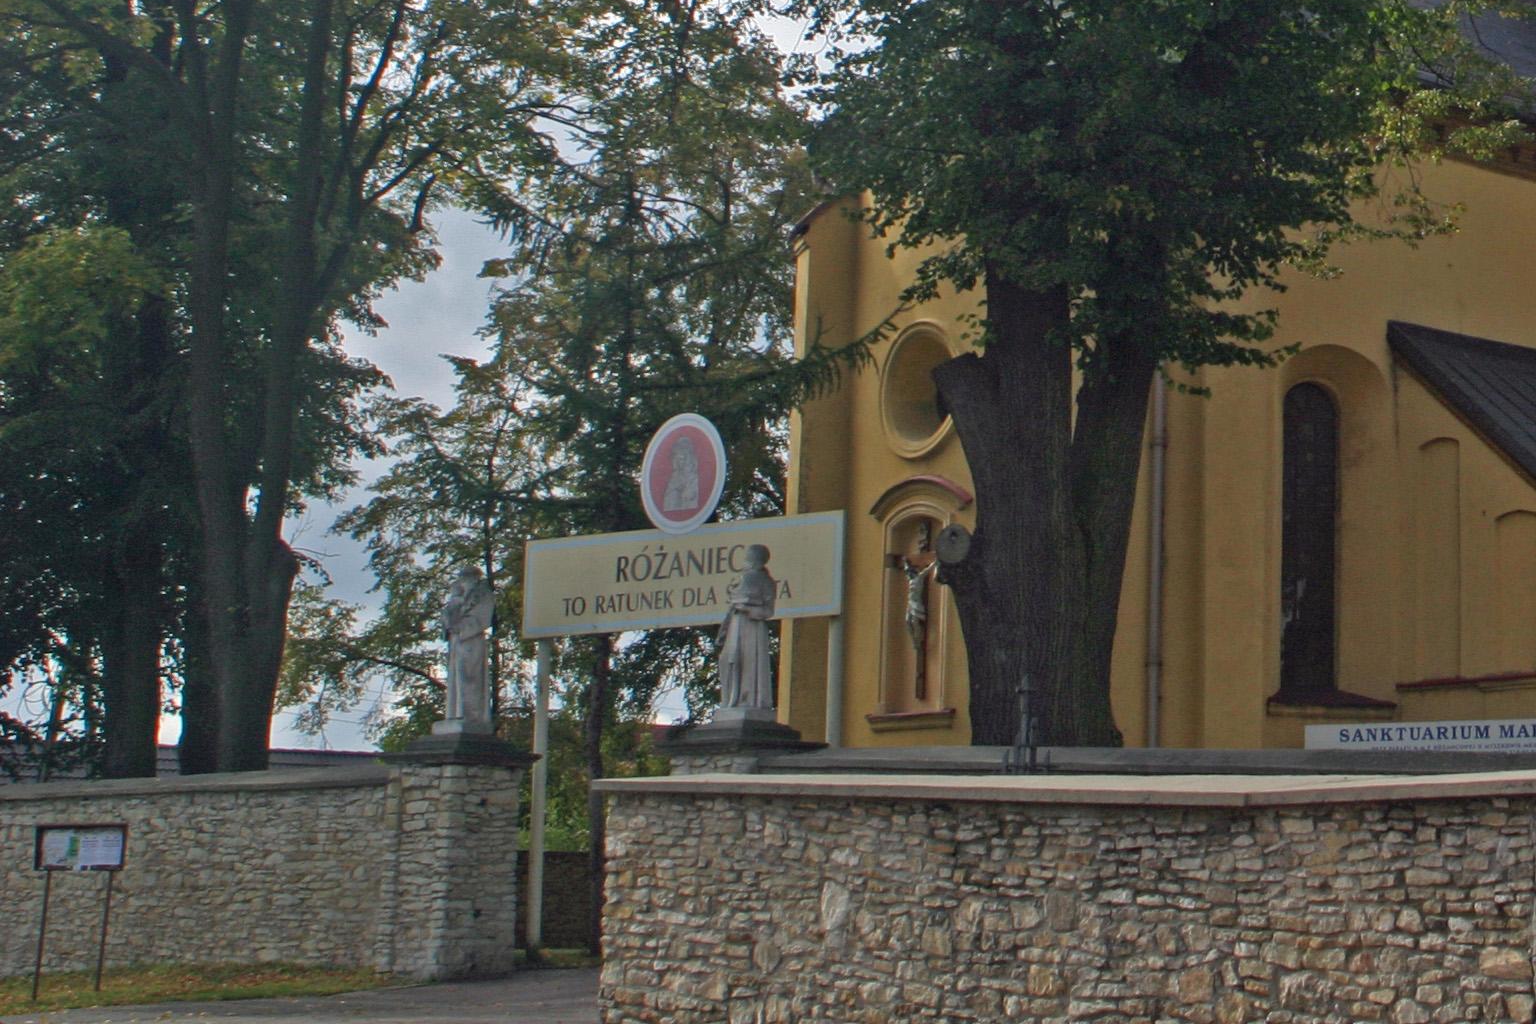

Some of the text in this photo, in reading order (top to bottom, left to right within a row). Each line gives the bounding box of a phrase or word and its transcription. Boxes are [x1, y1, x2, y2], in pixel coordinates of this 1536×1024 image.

[615, 544, 745, 583] RÓŻANIEC
[562, 596, 586, 617] TO
[595, 589, 674, 615] RATUNEK
[682, 585, 717, 608] DLA
[1339, 725, 1490, 743] SANKTUARIUM
